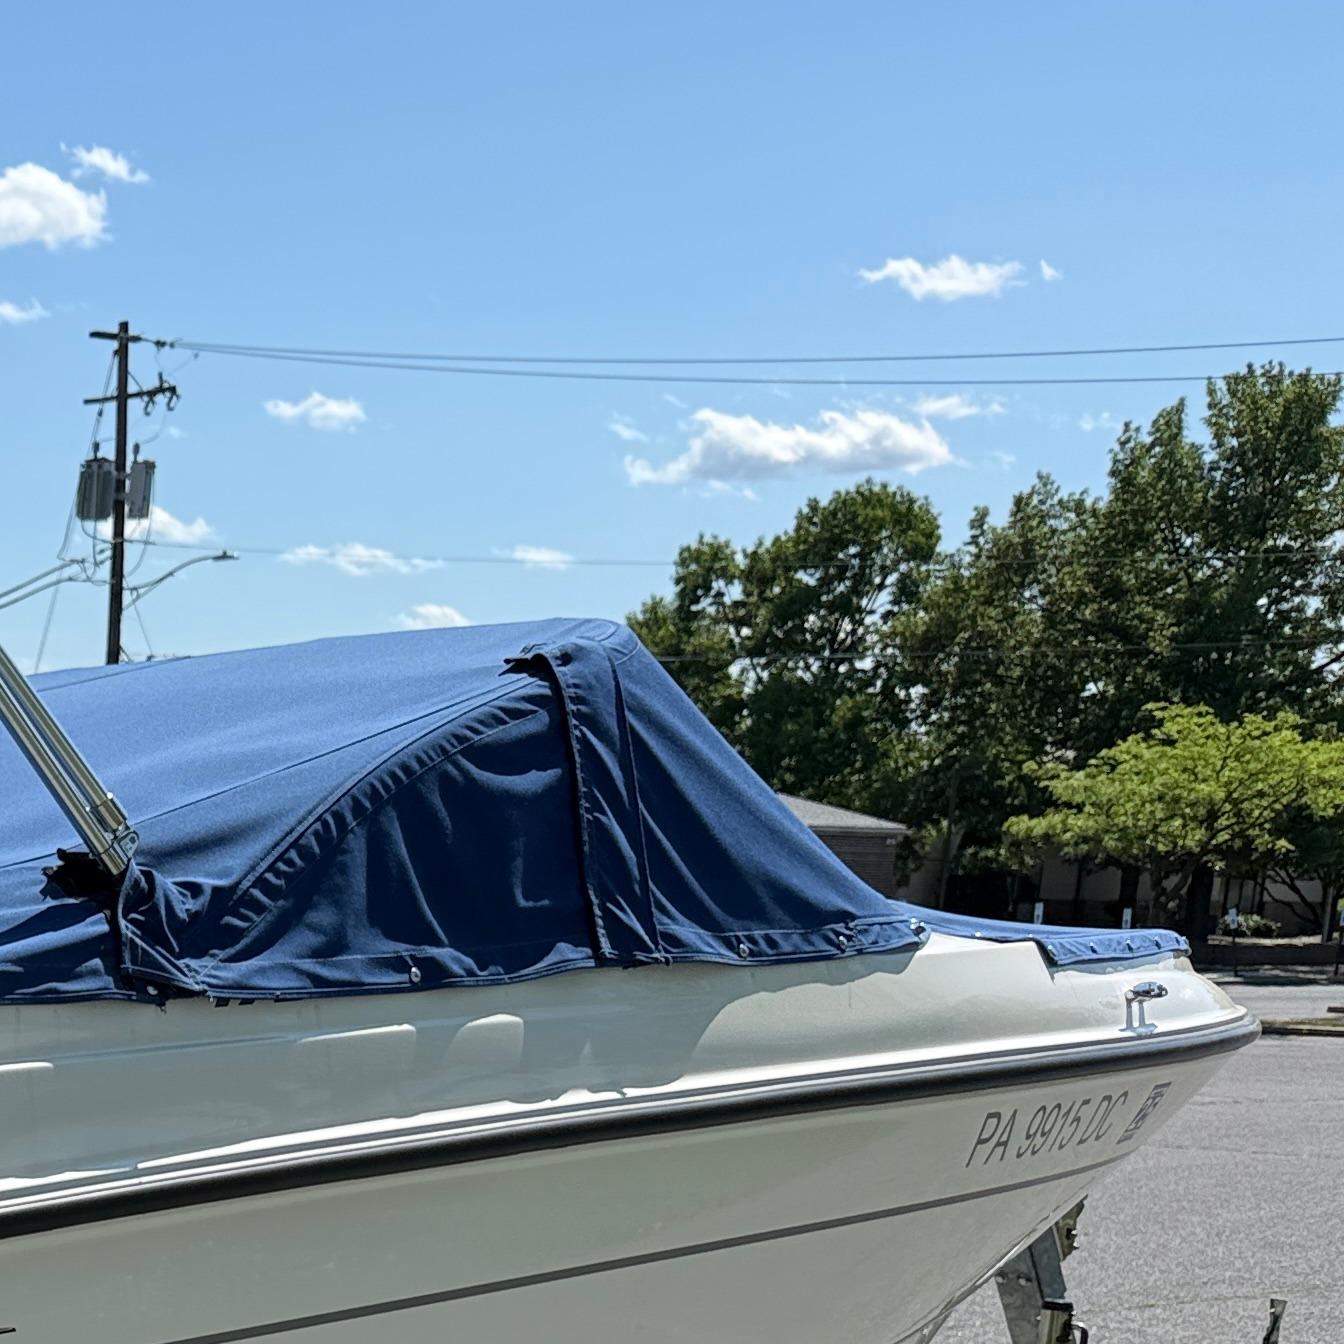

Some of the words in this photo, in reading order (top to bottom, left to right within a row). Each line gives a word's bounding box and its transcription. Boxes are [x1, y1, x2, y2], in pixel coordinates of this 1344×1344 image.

[965, 1108, 1018, 1168] PA
[1016, 1098, 1093, 1159] 9915
[1076, 1090, 1129, 1146] DC
